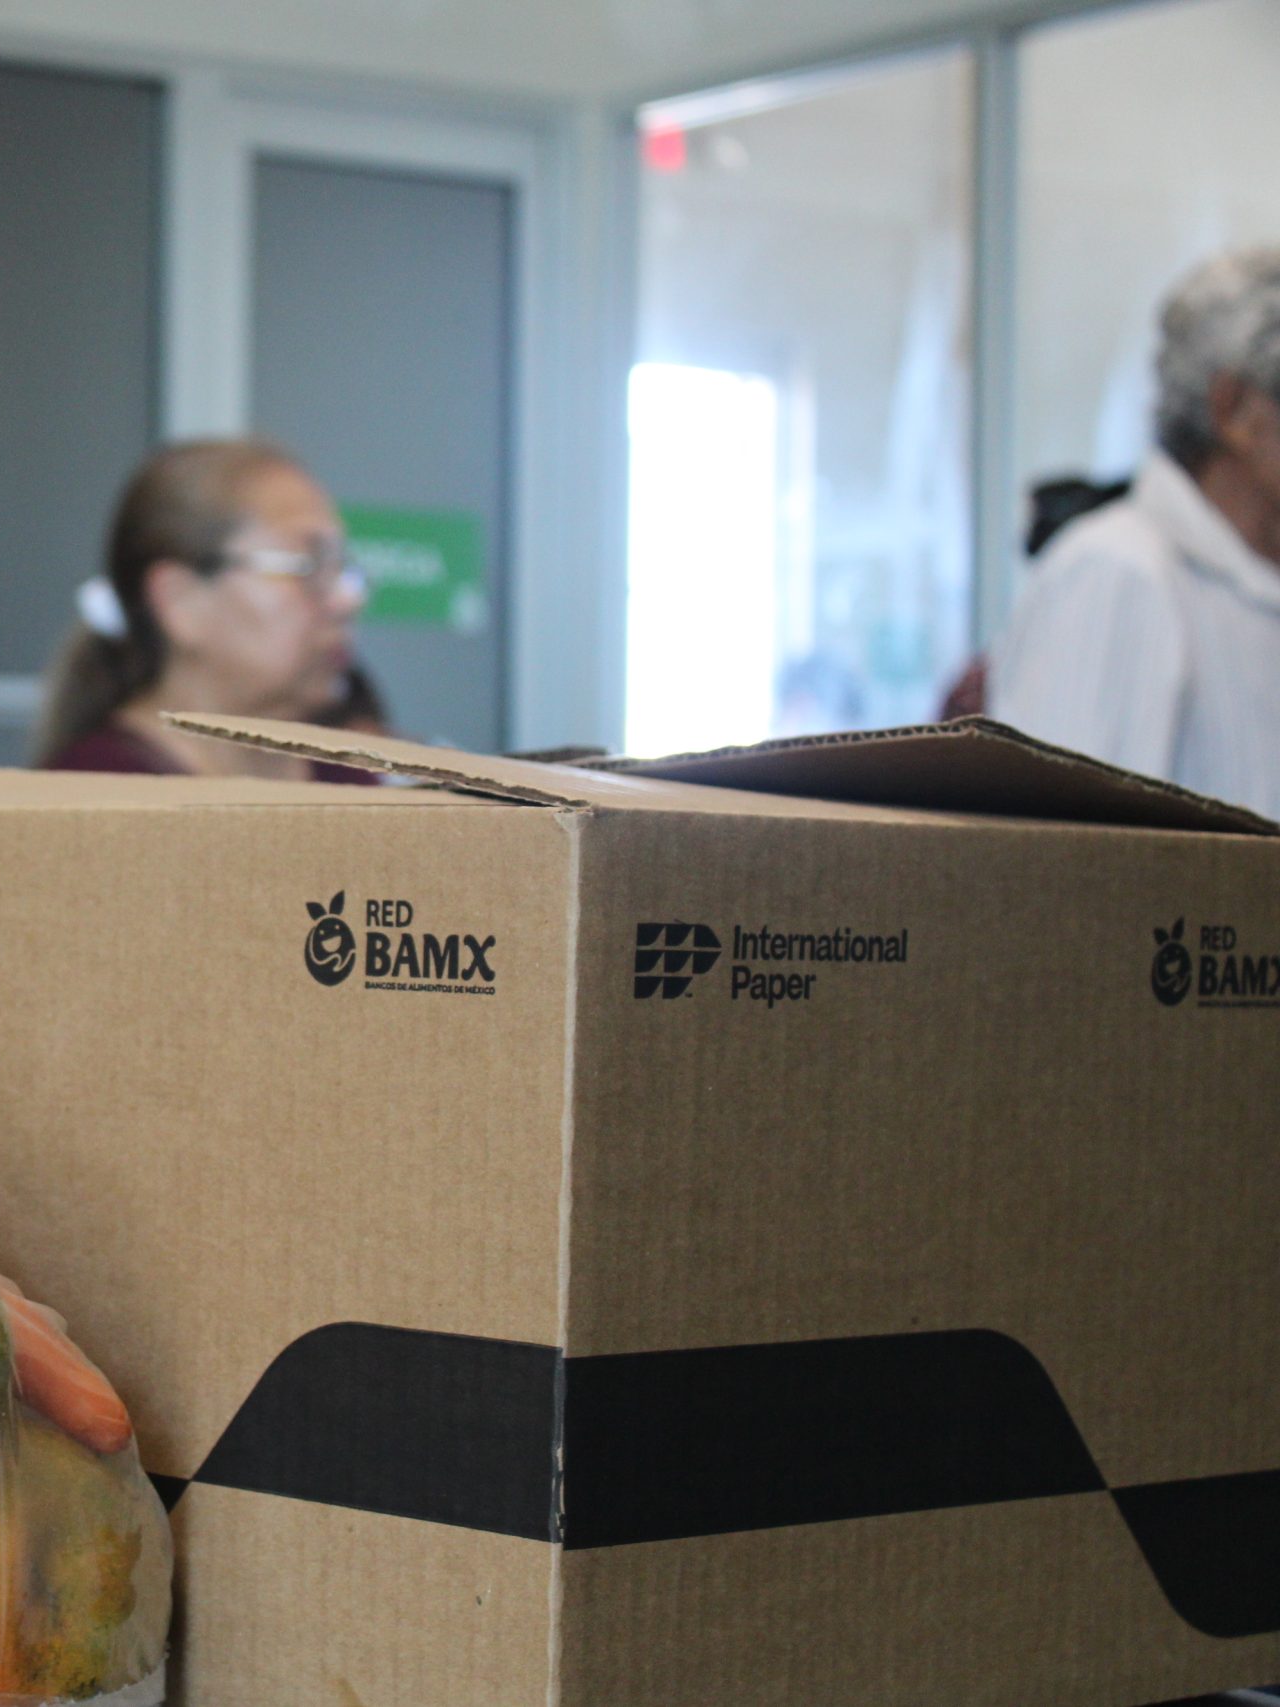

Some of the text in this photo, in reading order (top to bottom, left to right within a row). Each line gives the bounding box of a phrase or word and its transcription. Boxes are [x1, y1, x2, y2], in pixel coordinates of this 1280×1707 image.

[365, 899, 414, 928] RED
[732, 925, 909, 963] International
[1200, 925, 1237, 952] RED
[364, 932, 496, 982] BAMX
[364, 981, 396, 991] BANCOS
[397, 982, 407, 992] DE
[408, 983, 452, 994] ALIMENTOS
[454, 985, 465, 994] DE
[730, 965, 817, 1009] Paper
